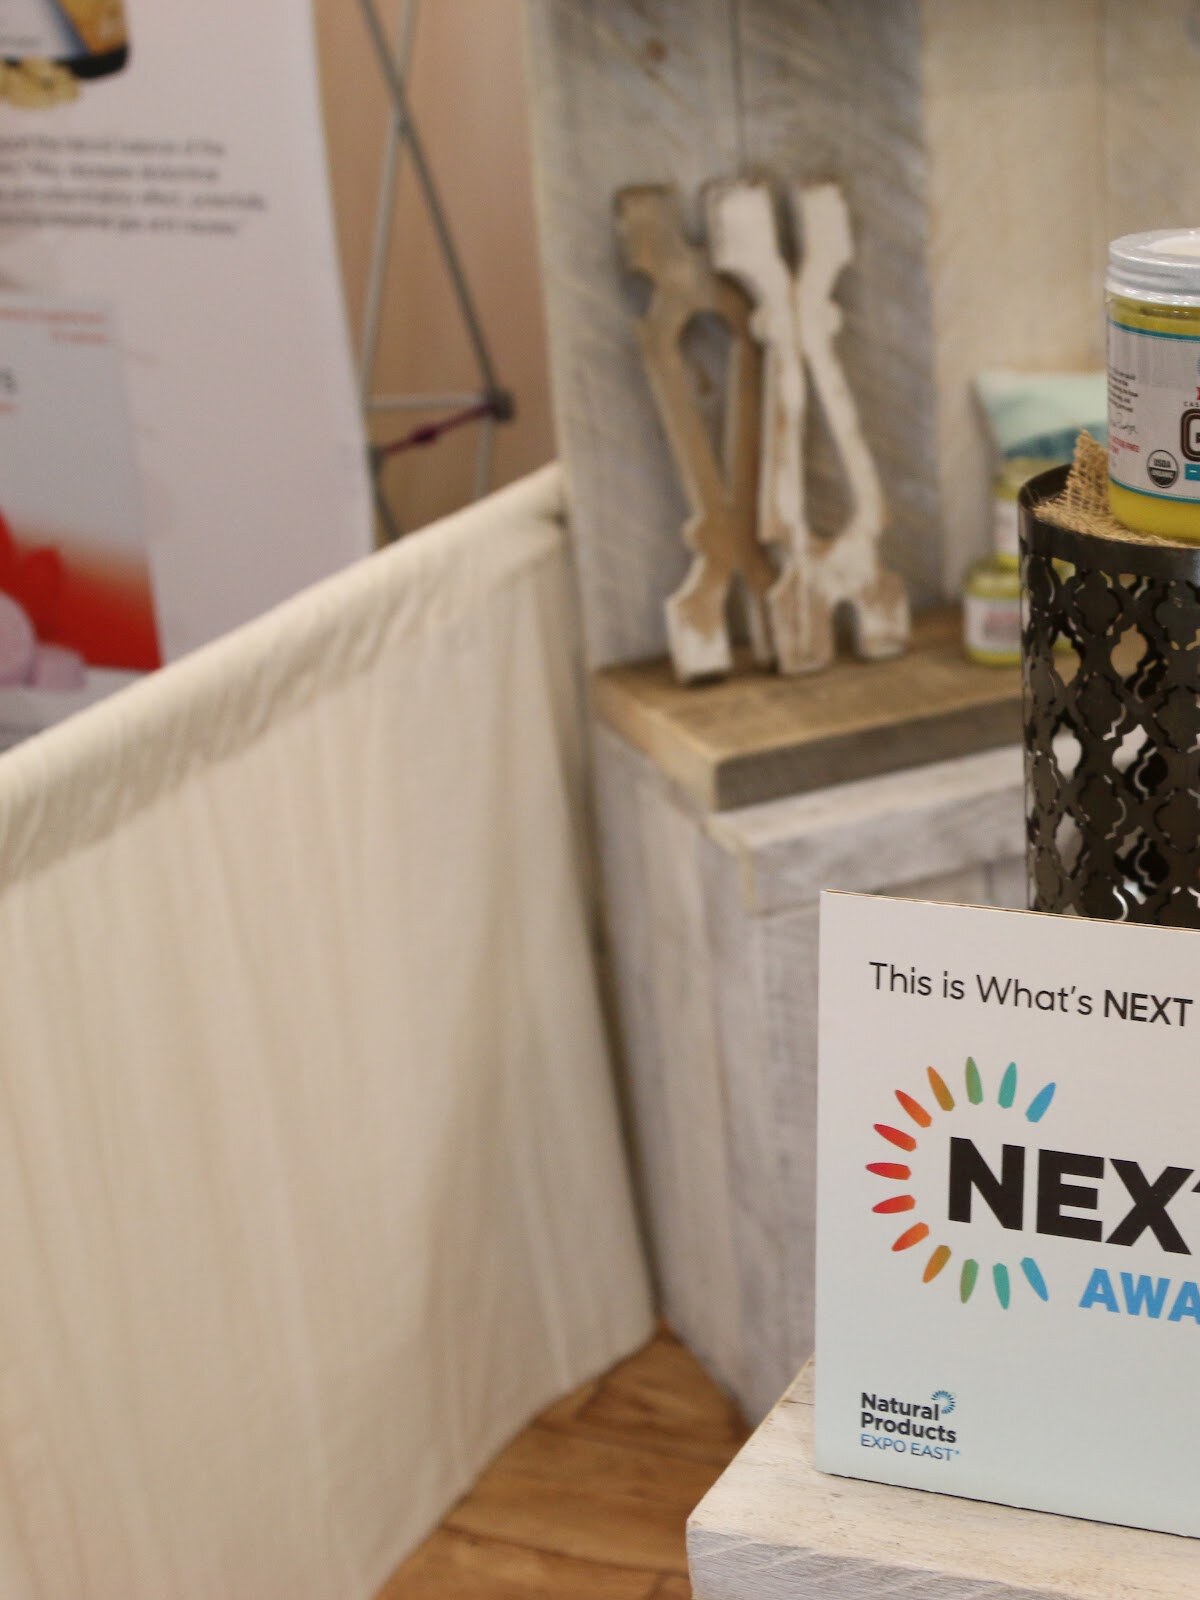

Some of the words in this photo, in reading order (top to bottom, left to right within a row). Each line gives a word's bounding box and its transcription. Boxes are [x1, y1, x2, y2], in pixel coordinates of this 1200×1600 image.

[868, 961, 932, 997] This
[942, 971, 965, 1000] is
[975, 974, 1093, 1016] What's
[1103, 991, 1194, 1028] NEXT
[861, 1392, 939, 1421] Natural
[861, 1412, 957, 1443] Products
[860, 1433, 906, 1453] EXPO
[910, 1443, 953, 1461] EAST
